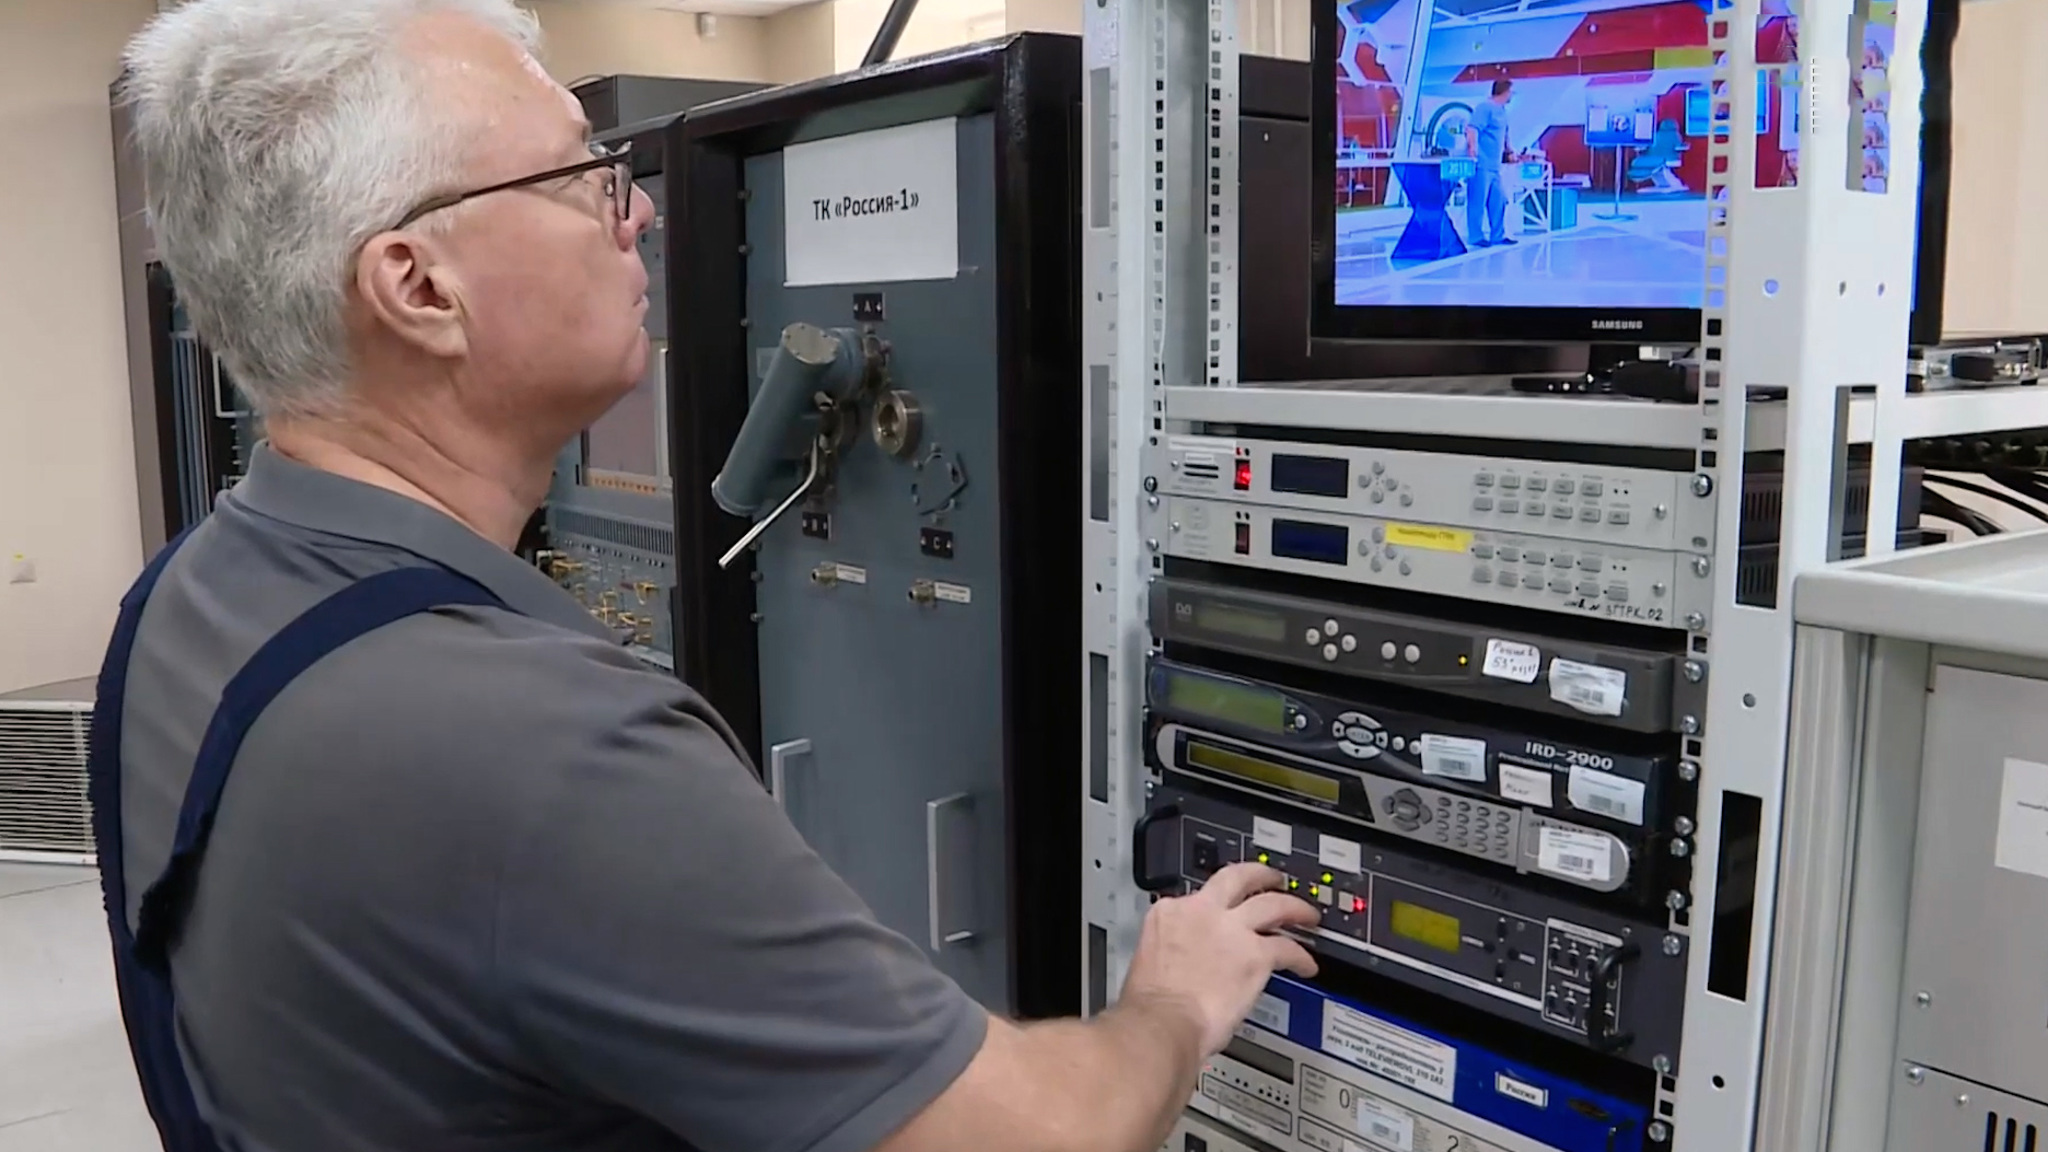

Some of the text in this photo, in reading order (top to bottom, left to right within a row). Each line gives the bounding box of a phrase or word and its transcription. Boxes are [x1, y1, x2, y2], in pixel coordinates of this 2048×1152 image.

[813, 187, 920, 220] ТК «Россия-1»
[863, 299, 872, 312] A
[1591, 320, 1643, 330] SAMSUNG
[1525, 741, 1613, 771] IRD-2900
